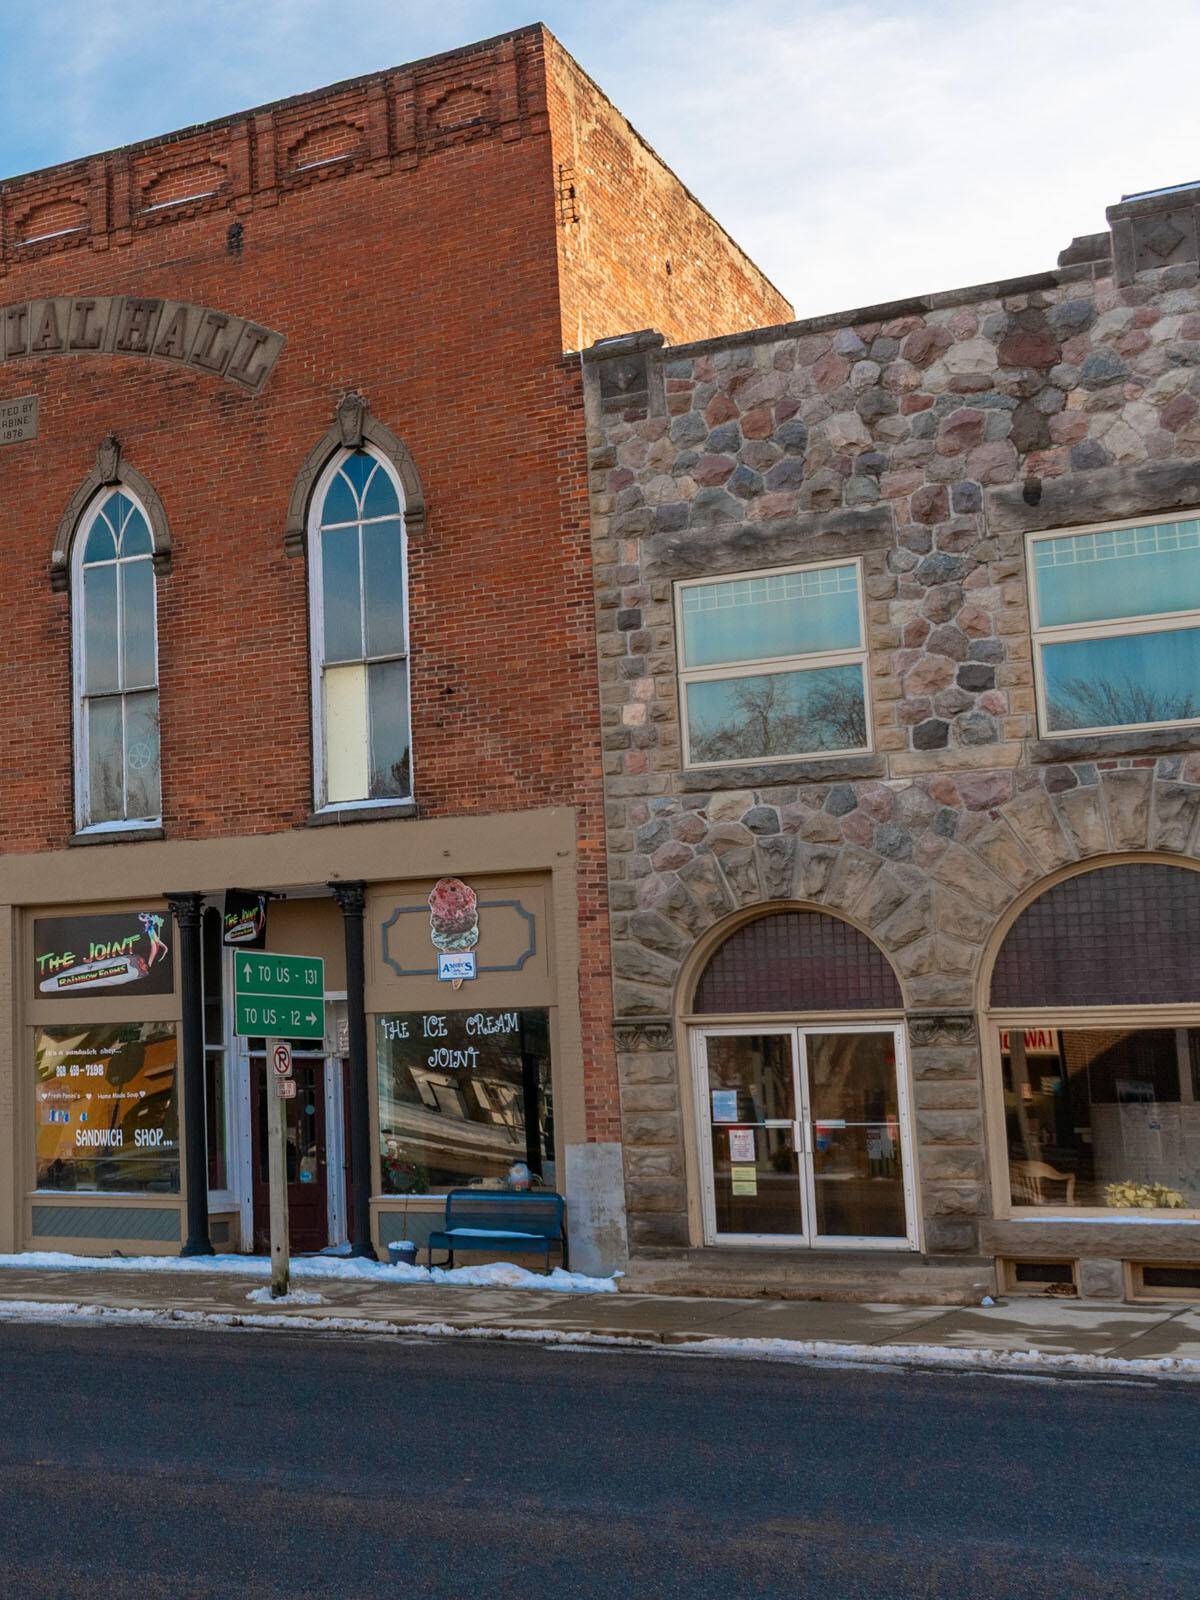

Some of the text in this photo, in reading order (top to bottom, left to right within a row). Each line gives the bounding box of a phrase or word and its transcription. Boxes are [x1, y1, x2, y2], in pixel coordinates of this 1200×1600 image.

[116, 301, 270, 382] HALL
[22, 402, 33, 413] BY
[225, 907, 258, 928] THE JOINT
[36, 934, 141, 975] THE JOINT
[258, 966, 271, 982] TO
[277, 968, 290, 983] US
[305, 970, 317, 984] 131
[245, 1008, 257, 1024] TO
[263, 1009, 276, 1024] US
[291, 1010, 300, 1026] 12
[381, 1012, 519, 1040] THE ICE CREAM
[428, 1046, 480, 1068] JOINT
[75, 1128, 123, 1146] SANDWICH
